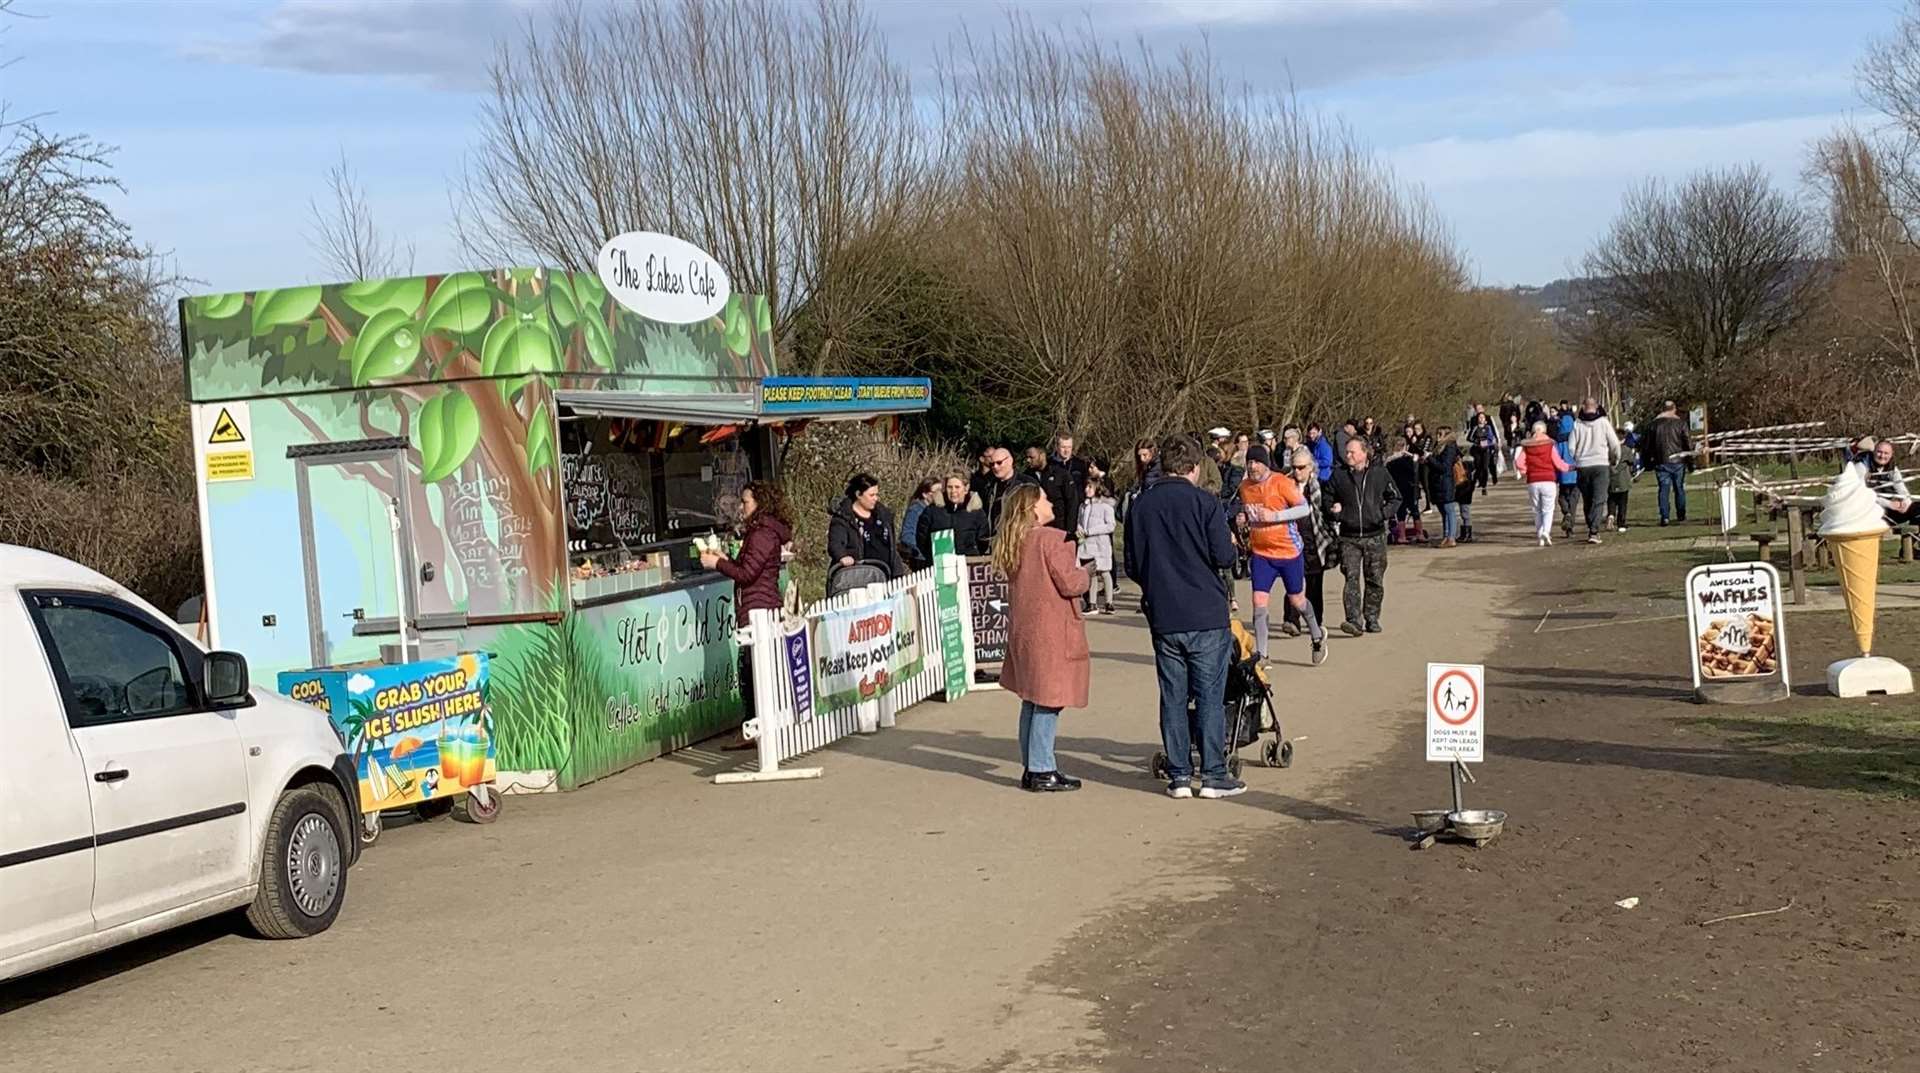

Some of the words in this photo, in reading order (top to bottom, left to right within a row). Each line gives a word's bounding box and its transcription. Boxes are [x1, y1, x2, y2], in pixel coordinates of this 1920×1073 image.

[610, 247, 640, 290] The
[646, 253, 685, 295] Lakes
[689, 260, 717, 305] Cafe
[764, 386, 788, 401] PLEASE
[788, 386, 805, 401] KEEP
[805, 386, 833, 400] FOOTPATH
[834, 386, 852, 400] CLEAR
[1698, 585, 1768, 607] WAFFLES
[1709, 577, 1755, 587] AWESOME
[972, 600, 988, 614] AY
[617, 611, 656, 667] Hot
[675, 599, 711, 653] Cold
[845, 650, 868, 672] Keep
[896, 630, 915, 651] Clear
[292, 679, 324, 700] COOL
[375, 682, 422, 711] GRAB
[423, 671, 465, 697] YOUR
[606, 692, 642, 736] Coffee
[647, 680, 671, 717] Cold
[365, 716, 392, 739] ICE
[394, 702, 440, 731] SLUSH
[444, 691, 482, 717] HERE
